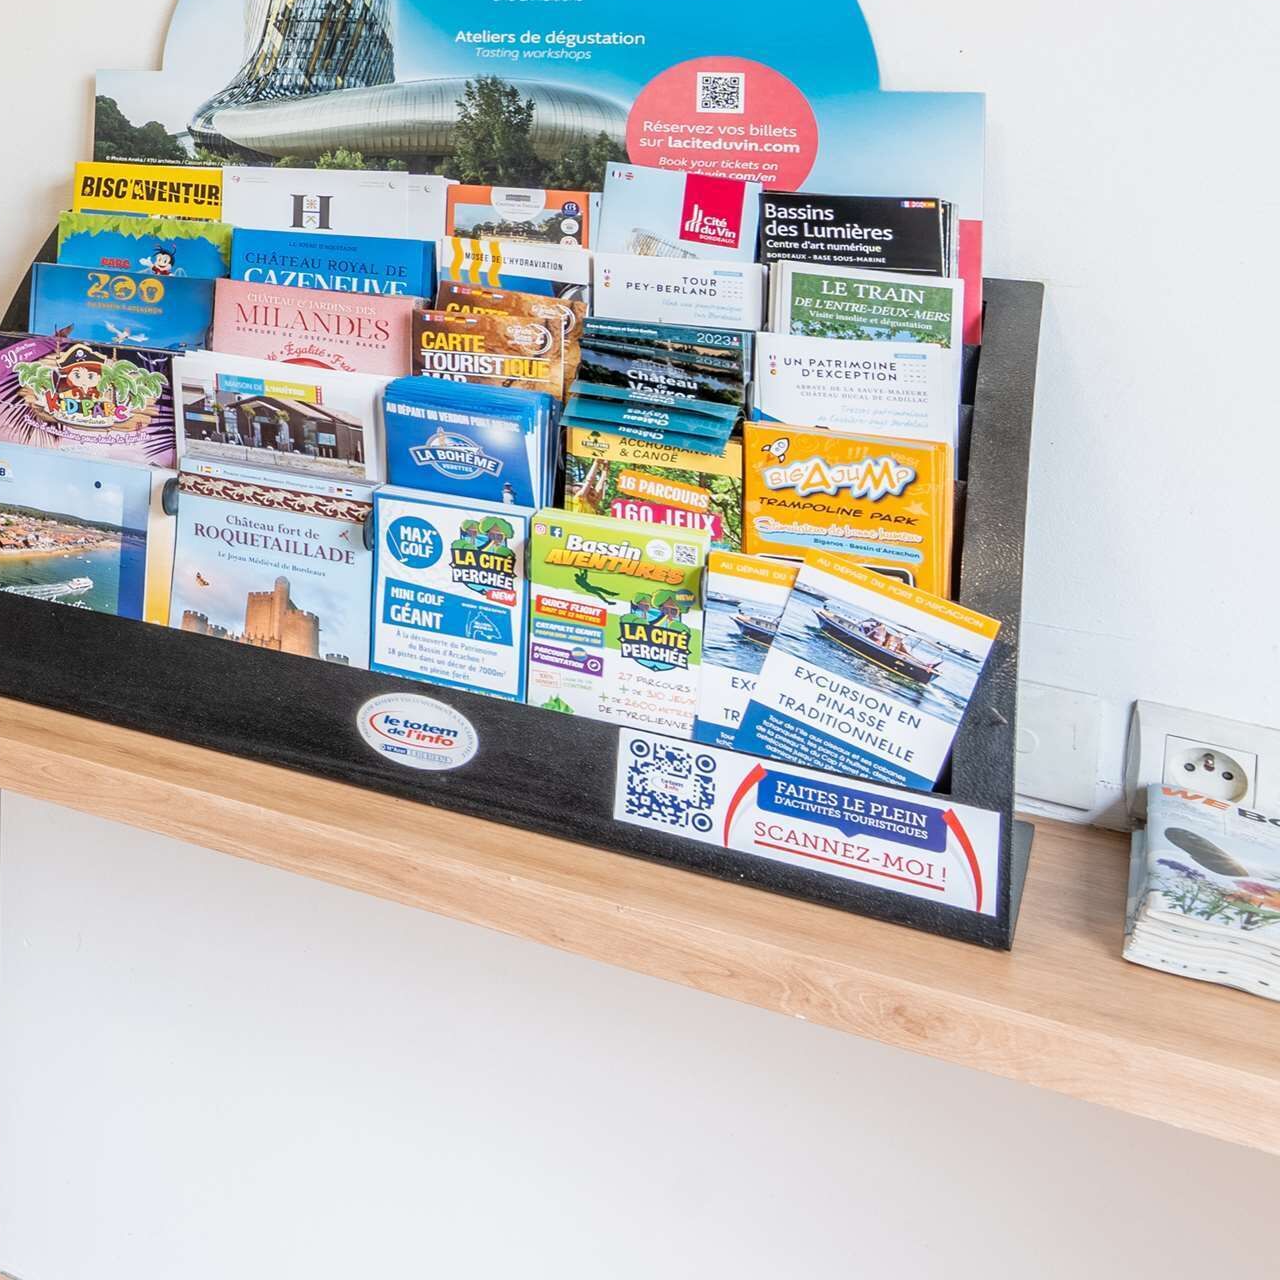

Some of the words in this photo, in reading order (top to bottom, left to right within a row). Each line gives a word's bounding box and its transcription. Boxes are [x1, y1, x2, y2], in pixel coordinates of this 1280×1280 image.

[455, 31, 516, 44] Ateliers
[520, 32, 540, 44] de
[545, 31, 645, 47] dégustation
[475, 47, 520, 60] Tasting
[523, 48, 592, 61] workshops
[643, 121, 714, 135] Réservez
[718, 125, 745, 136] vos
[749, 124, 797, 138] billets
[640, 137, 664, 148] sur
[668, 136, 800, 153] laciteduvin.com
[659, 157, 688, 167] Book
[690, 160, 719, 169] your
[721, 159, 759, 170] tickets
[762, 162, 778, 170] on
[703, 216, 728, 228] Cité
[765, 204, 834, 221] Bassins
[699, 234, 736, 245] BORDEAUX
[700, 225, 716, 235] du
[716, 226, 737, 239] Vin
[765, 221, 798, 236] des
[804, 223, 893, 241] Lumières
[766, 240, 799, 250] Centre
[802, 240, 824, 251] d'art
[827, 241, 882, 253] numérique
[245, 252, 321, 269] CHÂTEAU
[328, 259, 378, 275] ROYAL
[386, 266, 408, 278] DE
[766, 252, 806, 260] BORDEAUX
[833, 255, 886, 264] SOUS-MARINE
[626, 282, 717, 297] PEY-BERLAND
[681, 277, 717, 286] TOUR
[821, 280, 848, 296] LE
[854, 283, 925, 305] TRAIN
[795, 296, 813, 307] DE
[814, 299, 952, 323] L'ENTRE-DEUX-MERS
[236, 303, 390, 342] MILANDES
[809, 309, 834, 320] Visite
[836, 312, 868, 324] insolite
[870, 316, 878, 324] et
[880, 316, 933, 331] dégustation
[421, 330, 485, 353] CARTE
[696, 332, 732, 346] 2023
[783, 358, 803, 366] UN
[809, 359, 897, 371] PATRIMOINE
[802, 368, 898, 381] D'EXCEPTION
[620, 475, 636, 490] 16
[639, 479, 708, 508] PARCOURS
[759, 497, 864, 517] TRAMPOLINE
[870, 512, 919, 526] PARK
[226, 514, 275, 533] Château
[278, 524, 303, 539] fort
[307, 529, 320, 540] de
[400, 525, 433, 544] MAX
[193, 522, 356, 566] ROQUETAILLADE
[400, 542, 434, 558] GOLF
[813, 538, 843, 548] Biganos
[849, 543, 874, 552] Bassin
[875, 547, 920, 559] d'Arcachon
[454, 550, 476, 566] LA
[480, 554, 513, 573] CITÉ
[390, 587, 414, 601] MINI
[417, 592, 445, 606] GOLF
[491, 591, 515, 600] NEW
[624, 623, 647, 641] LA
[650, 628, 688, 649] CITÉ
[794, 666, 893, 720] EXCURSION
[898, 711, 922, 729] EN
[816, 695, 886, 732] PINASSE
[384, 715, 400, 726] le
[403, 720, 458, 737] totem
[388, 727, 405, 736] de
[406, 729, 454, 746] l'info
[776, 781, 838, 807] FAITES
[842, 798, 865, 814] LE
[869, 803, 927, 828] PLEIN
[1161, 787, 1231, 810] WE
[754, 820, 934, 879] SCANNEZ-MOI
[941, 866, 947, 882] !
